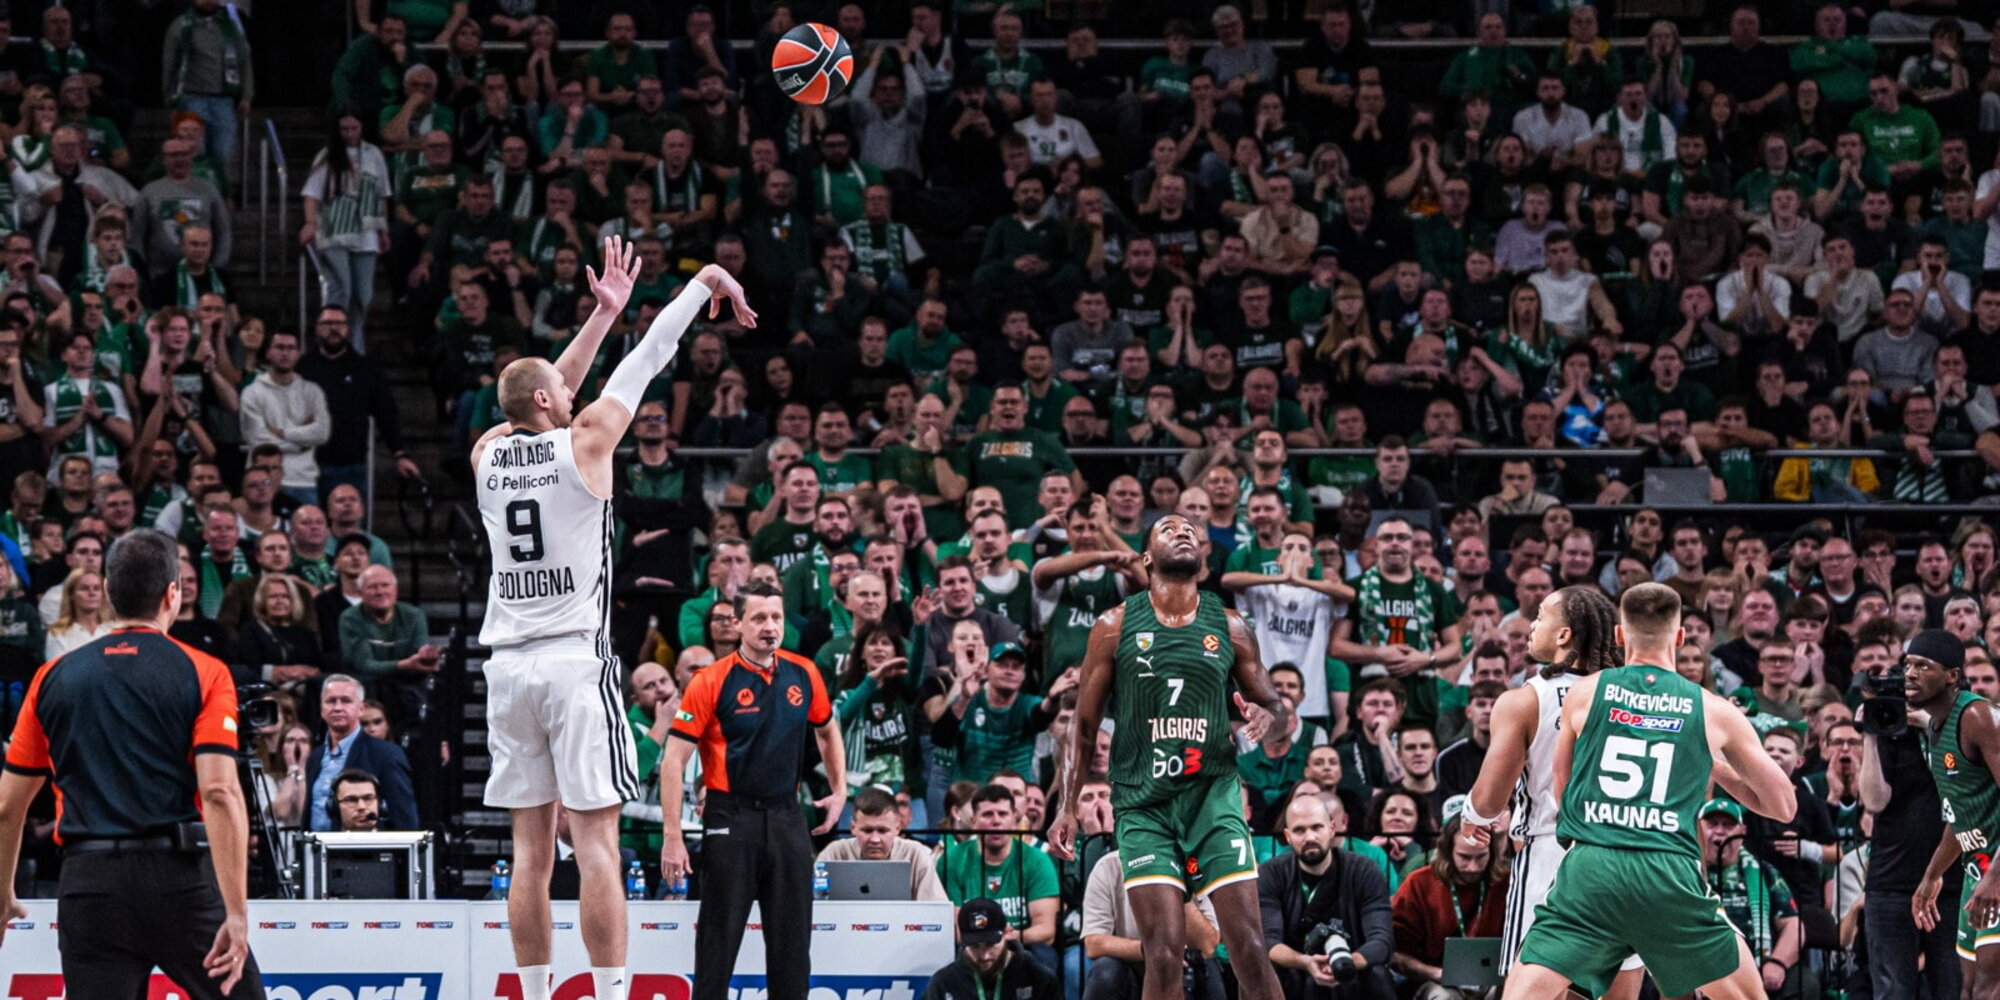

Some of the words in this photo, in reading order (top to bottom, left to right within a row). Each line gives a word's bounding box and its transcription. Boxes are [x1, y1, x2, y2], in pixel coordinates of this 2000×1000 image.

[502, 469, 559, 491] Pelliconi
[505, 499, 544, 563] 9
[498, 566, 574, 600] BOLOGNA
[1168, 679, 1184, 706] 7
[1603, 683, 1693, 715] BUTKEVIČIUS
[1149, 718, 1207, 743] ALGIRIS
[1598, 736, 1676, 806] 51
[1583, 801, 1680, 833] KAUNAS
[1231, 838, 1248, 866] 7
